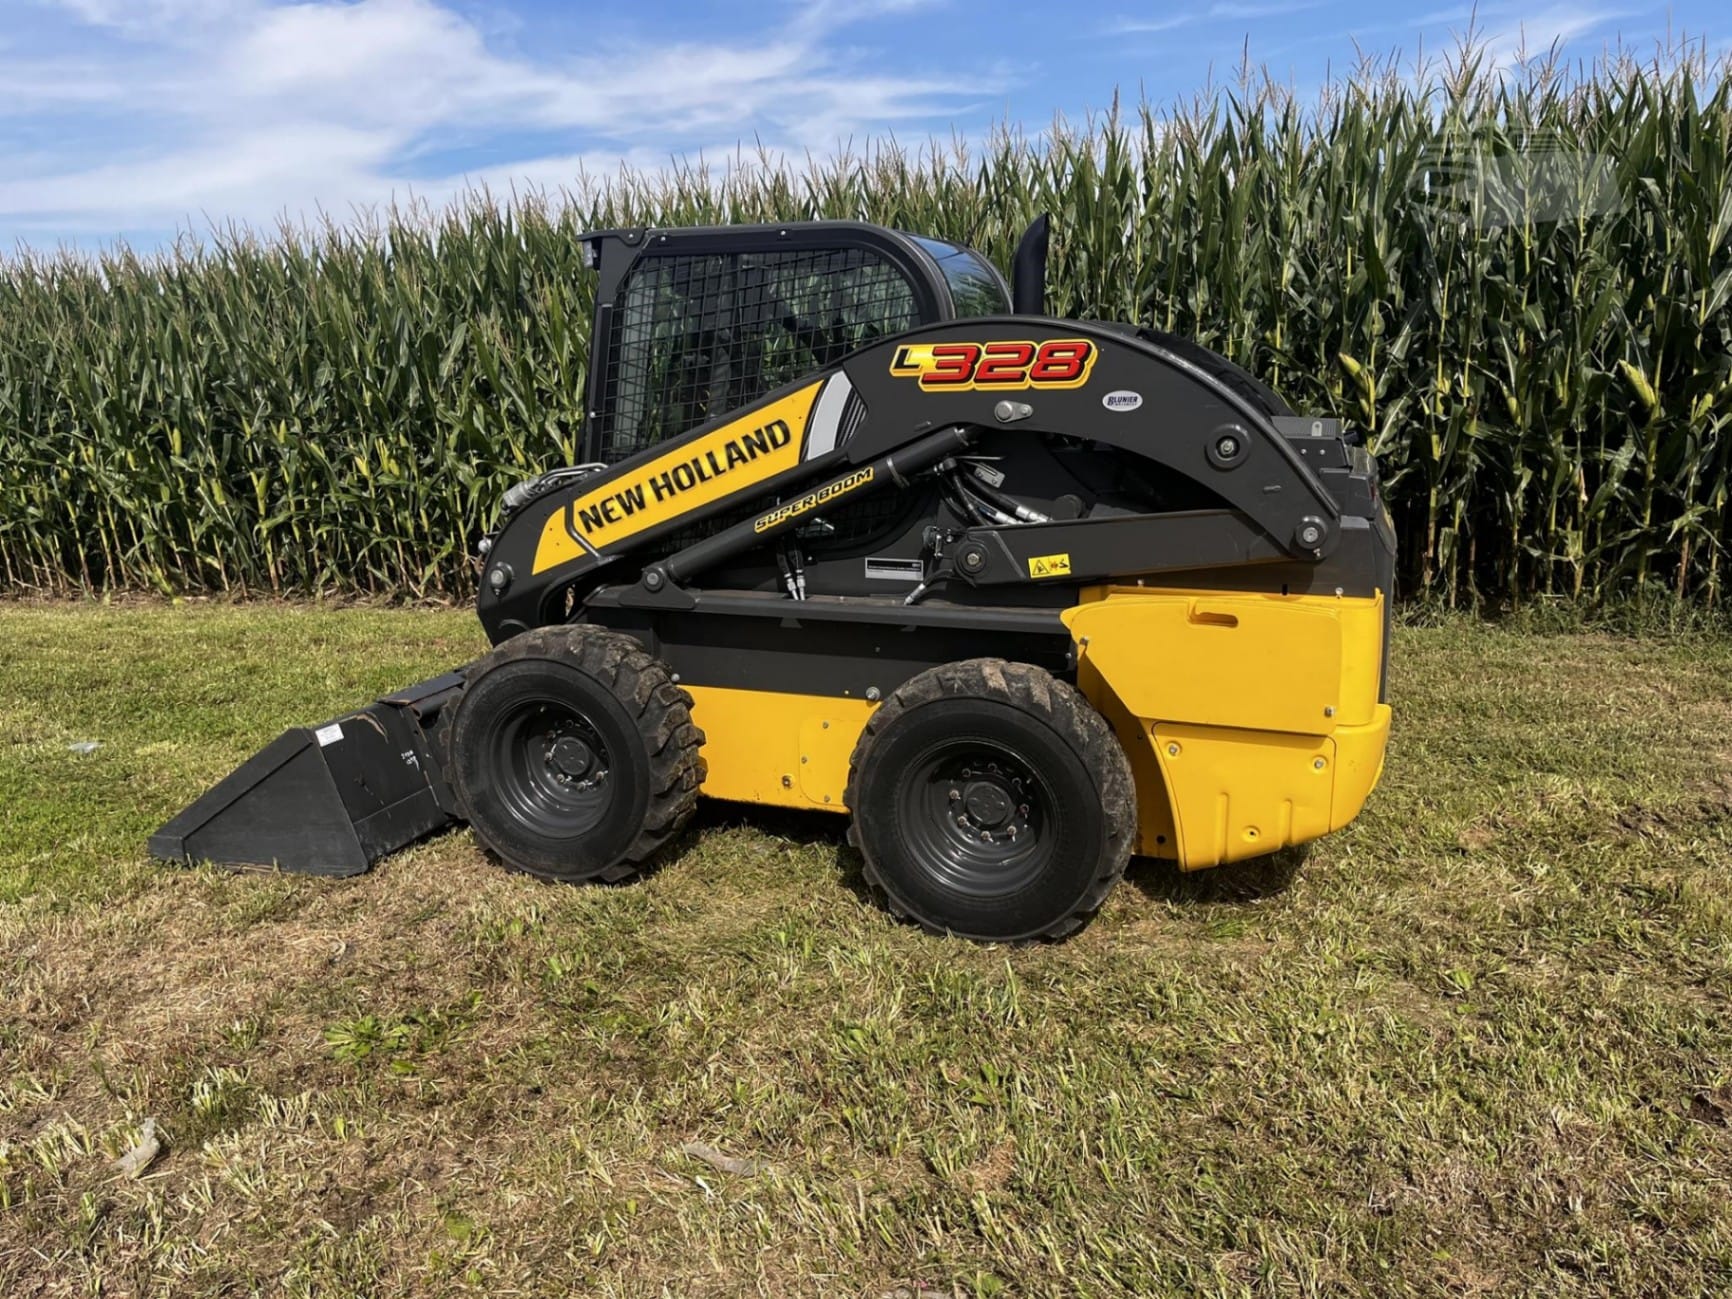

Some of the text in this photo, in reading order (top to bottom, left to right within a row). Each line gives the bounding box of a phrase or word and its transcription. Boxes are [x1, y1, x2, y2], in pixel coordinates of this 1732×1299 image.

[578, 419, 791, 534] NEW HOLLAND
[755, 466, 874, 533] SUPER BOOM
